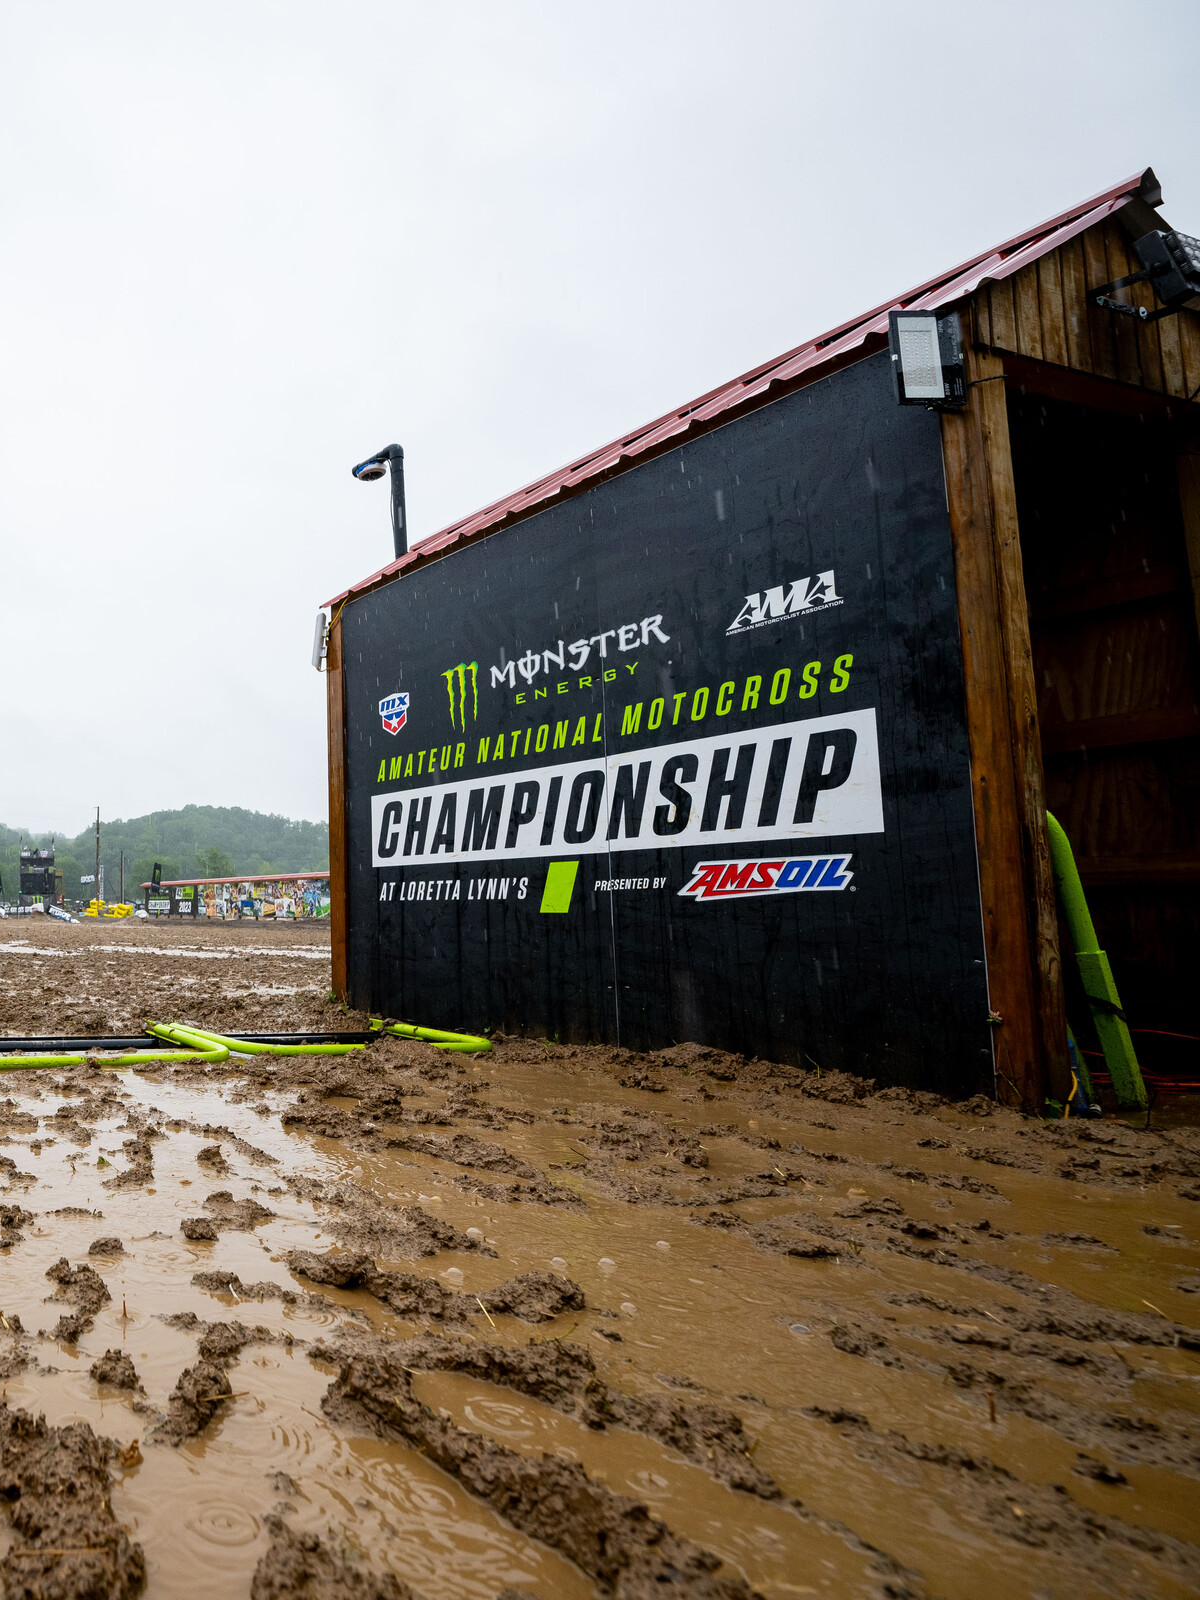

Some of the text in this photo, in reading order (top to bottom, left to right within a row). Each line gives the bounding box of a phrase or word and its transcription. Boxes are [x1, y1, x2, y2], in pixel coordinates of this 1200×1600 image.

[725, 599, 845, 637] AMERICAN MOTORCYCLIST ASSOCIATION
[726, 570, 844, 631] AMA
[515, 662, 639, 705] ENERGY
[377, 653, 855, 784] AMATEUR NATIONAL MOTOCROSS
[377, 728, 858, 859] CHAMPIONSHIP
[379, 876, 530, 902] AT LORETTA LYNN'S
[593, 877, 667, 893] PRESENTED BY
[697, 857, 852, 899] AMSOIL
